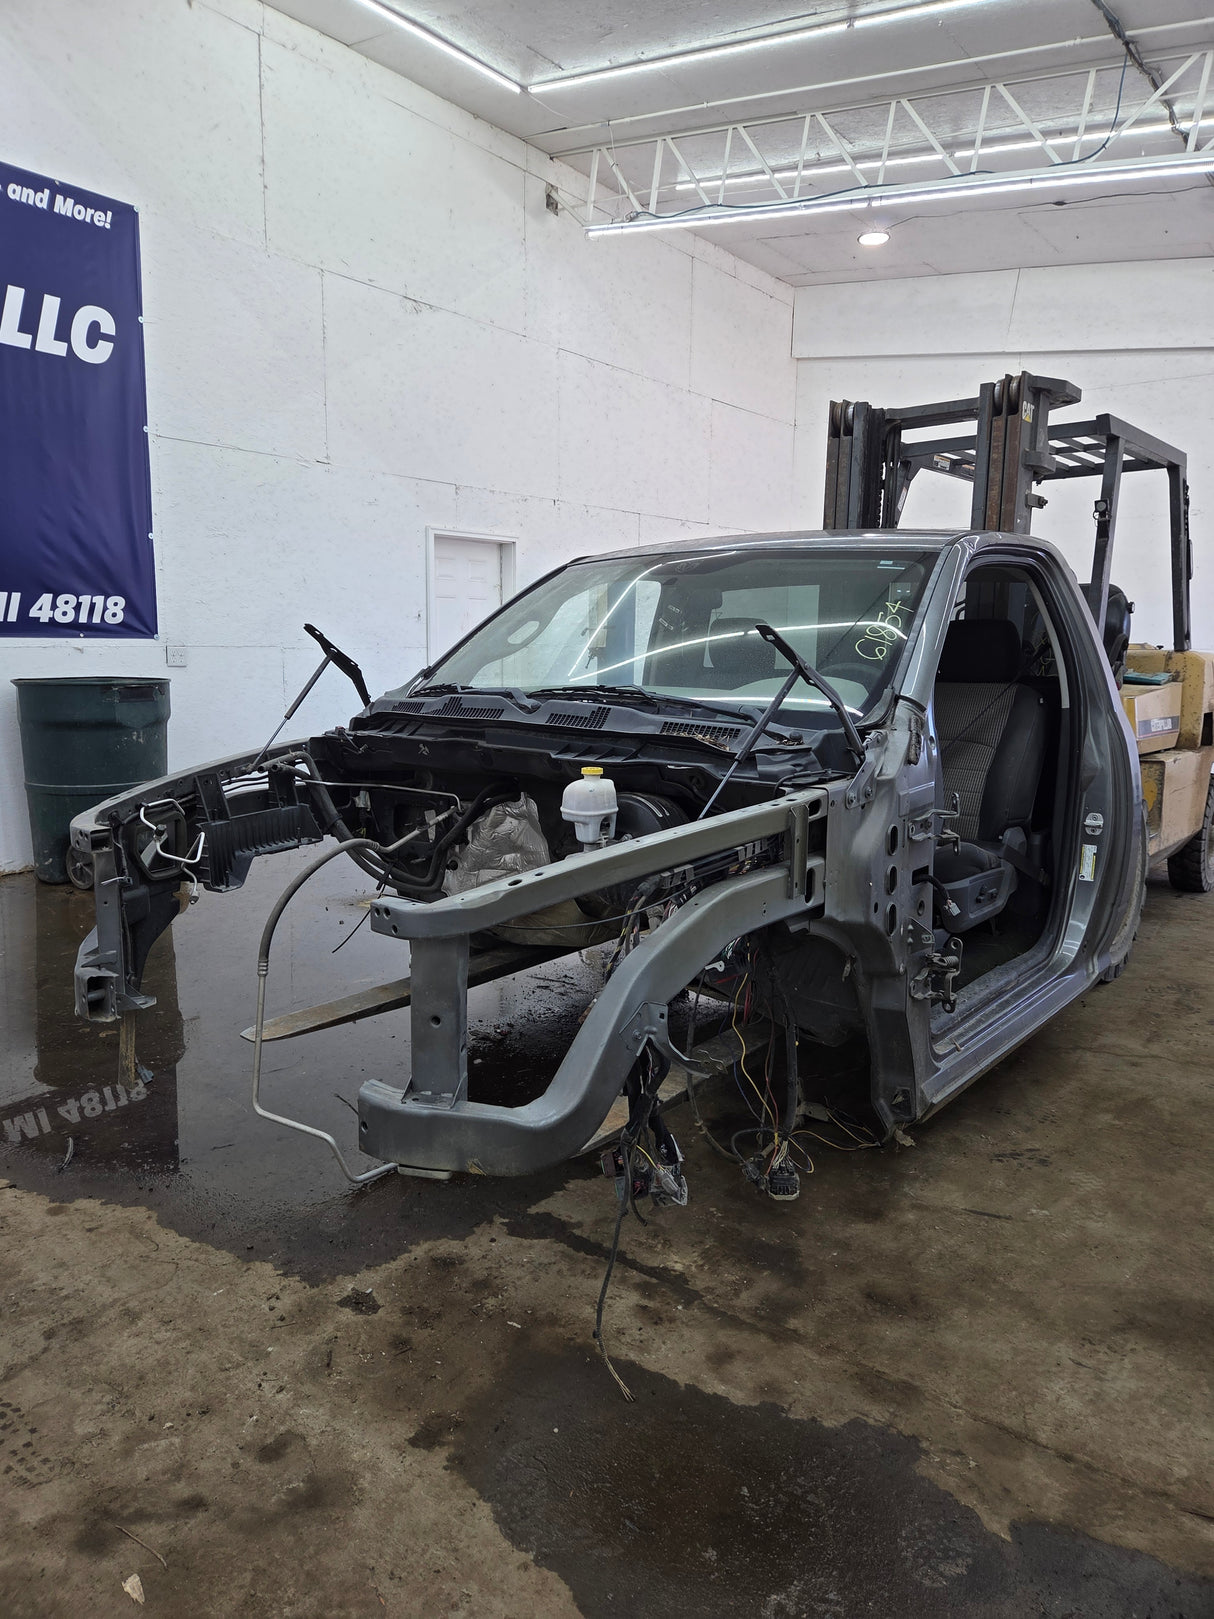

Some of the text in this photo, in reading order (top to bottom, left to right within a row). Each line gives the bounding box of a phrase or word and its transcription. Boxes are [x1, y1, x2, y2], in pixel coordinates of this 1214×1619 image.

[7, 182, 113, 229] and More!
[0, 284, 116, 365] LLC
[1022, 400, 1035, 423] CAT
[29, 593, 126, 624] 48118
[855, 600, 915, 660] 61854
